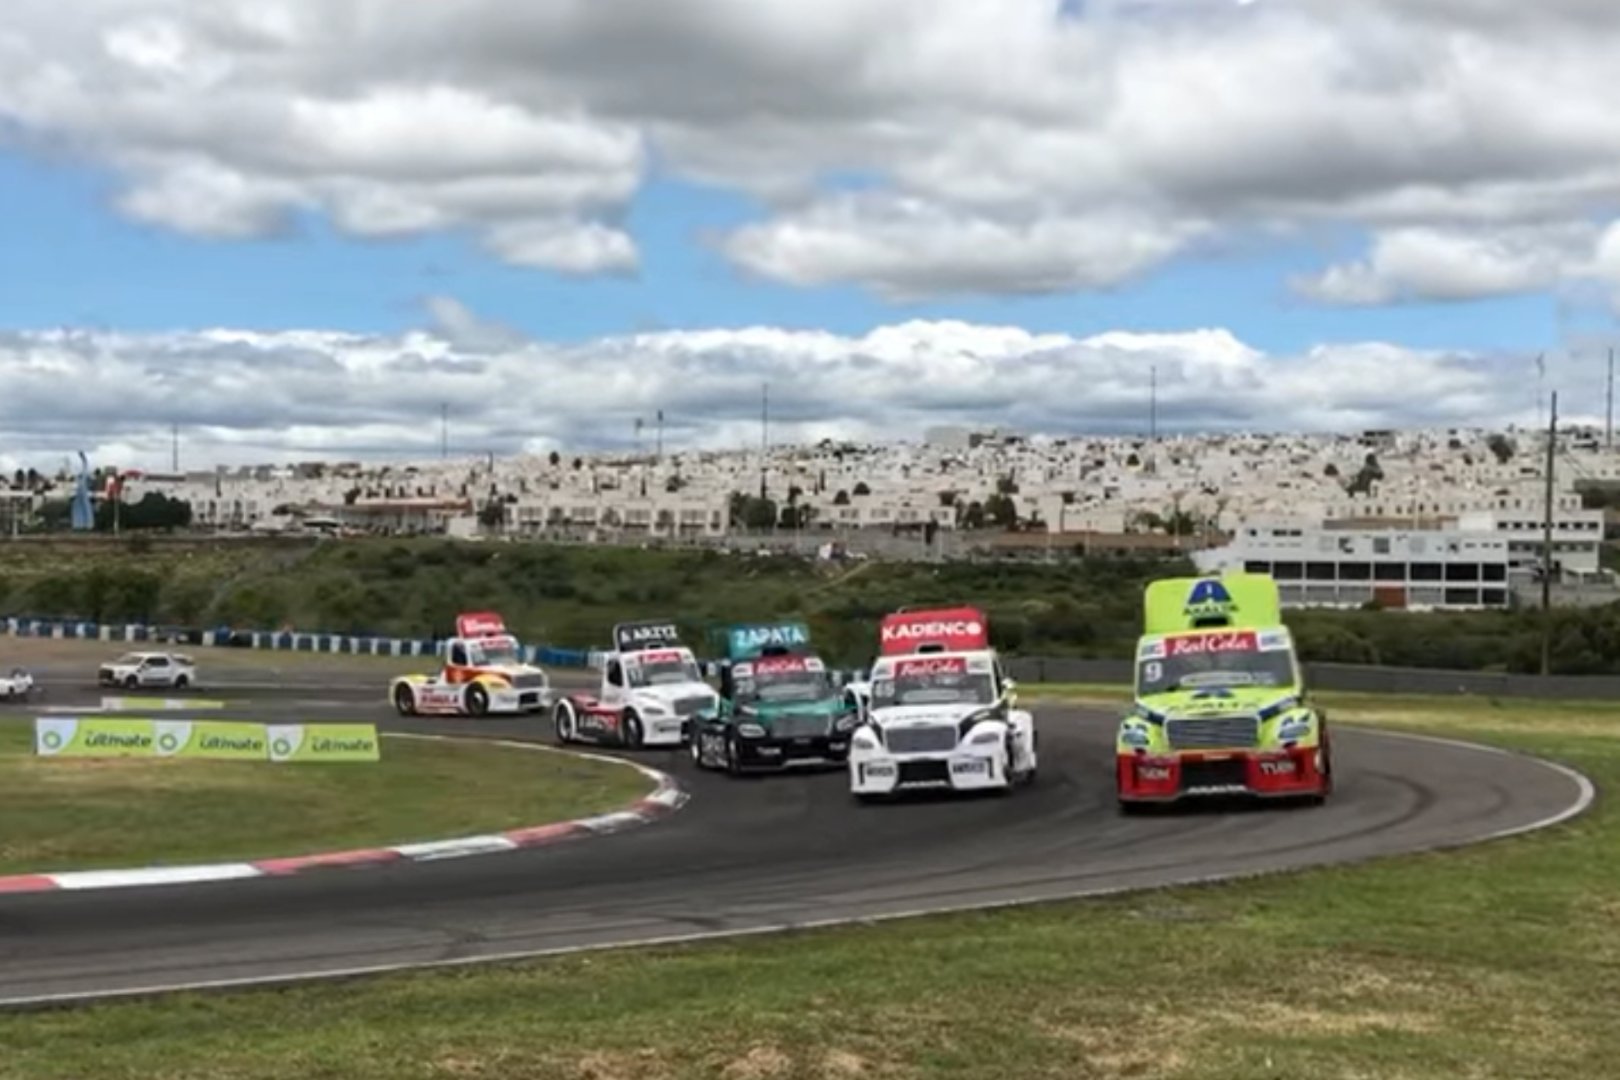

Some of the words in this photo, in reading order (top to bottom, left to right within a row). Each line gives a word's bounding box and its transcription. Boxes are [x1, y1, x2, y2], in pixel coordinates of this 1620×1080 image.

[735, 626, 806, 647] ZAPATA
[882, 621, 982, 641] KADENCO
[1145, 661, 1162, 682] 9
